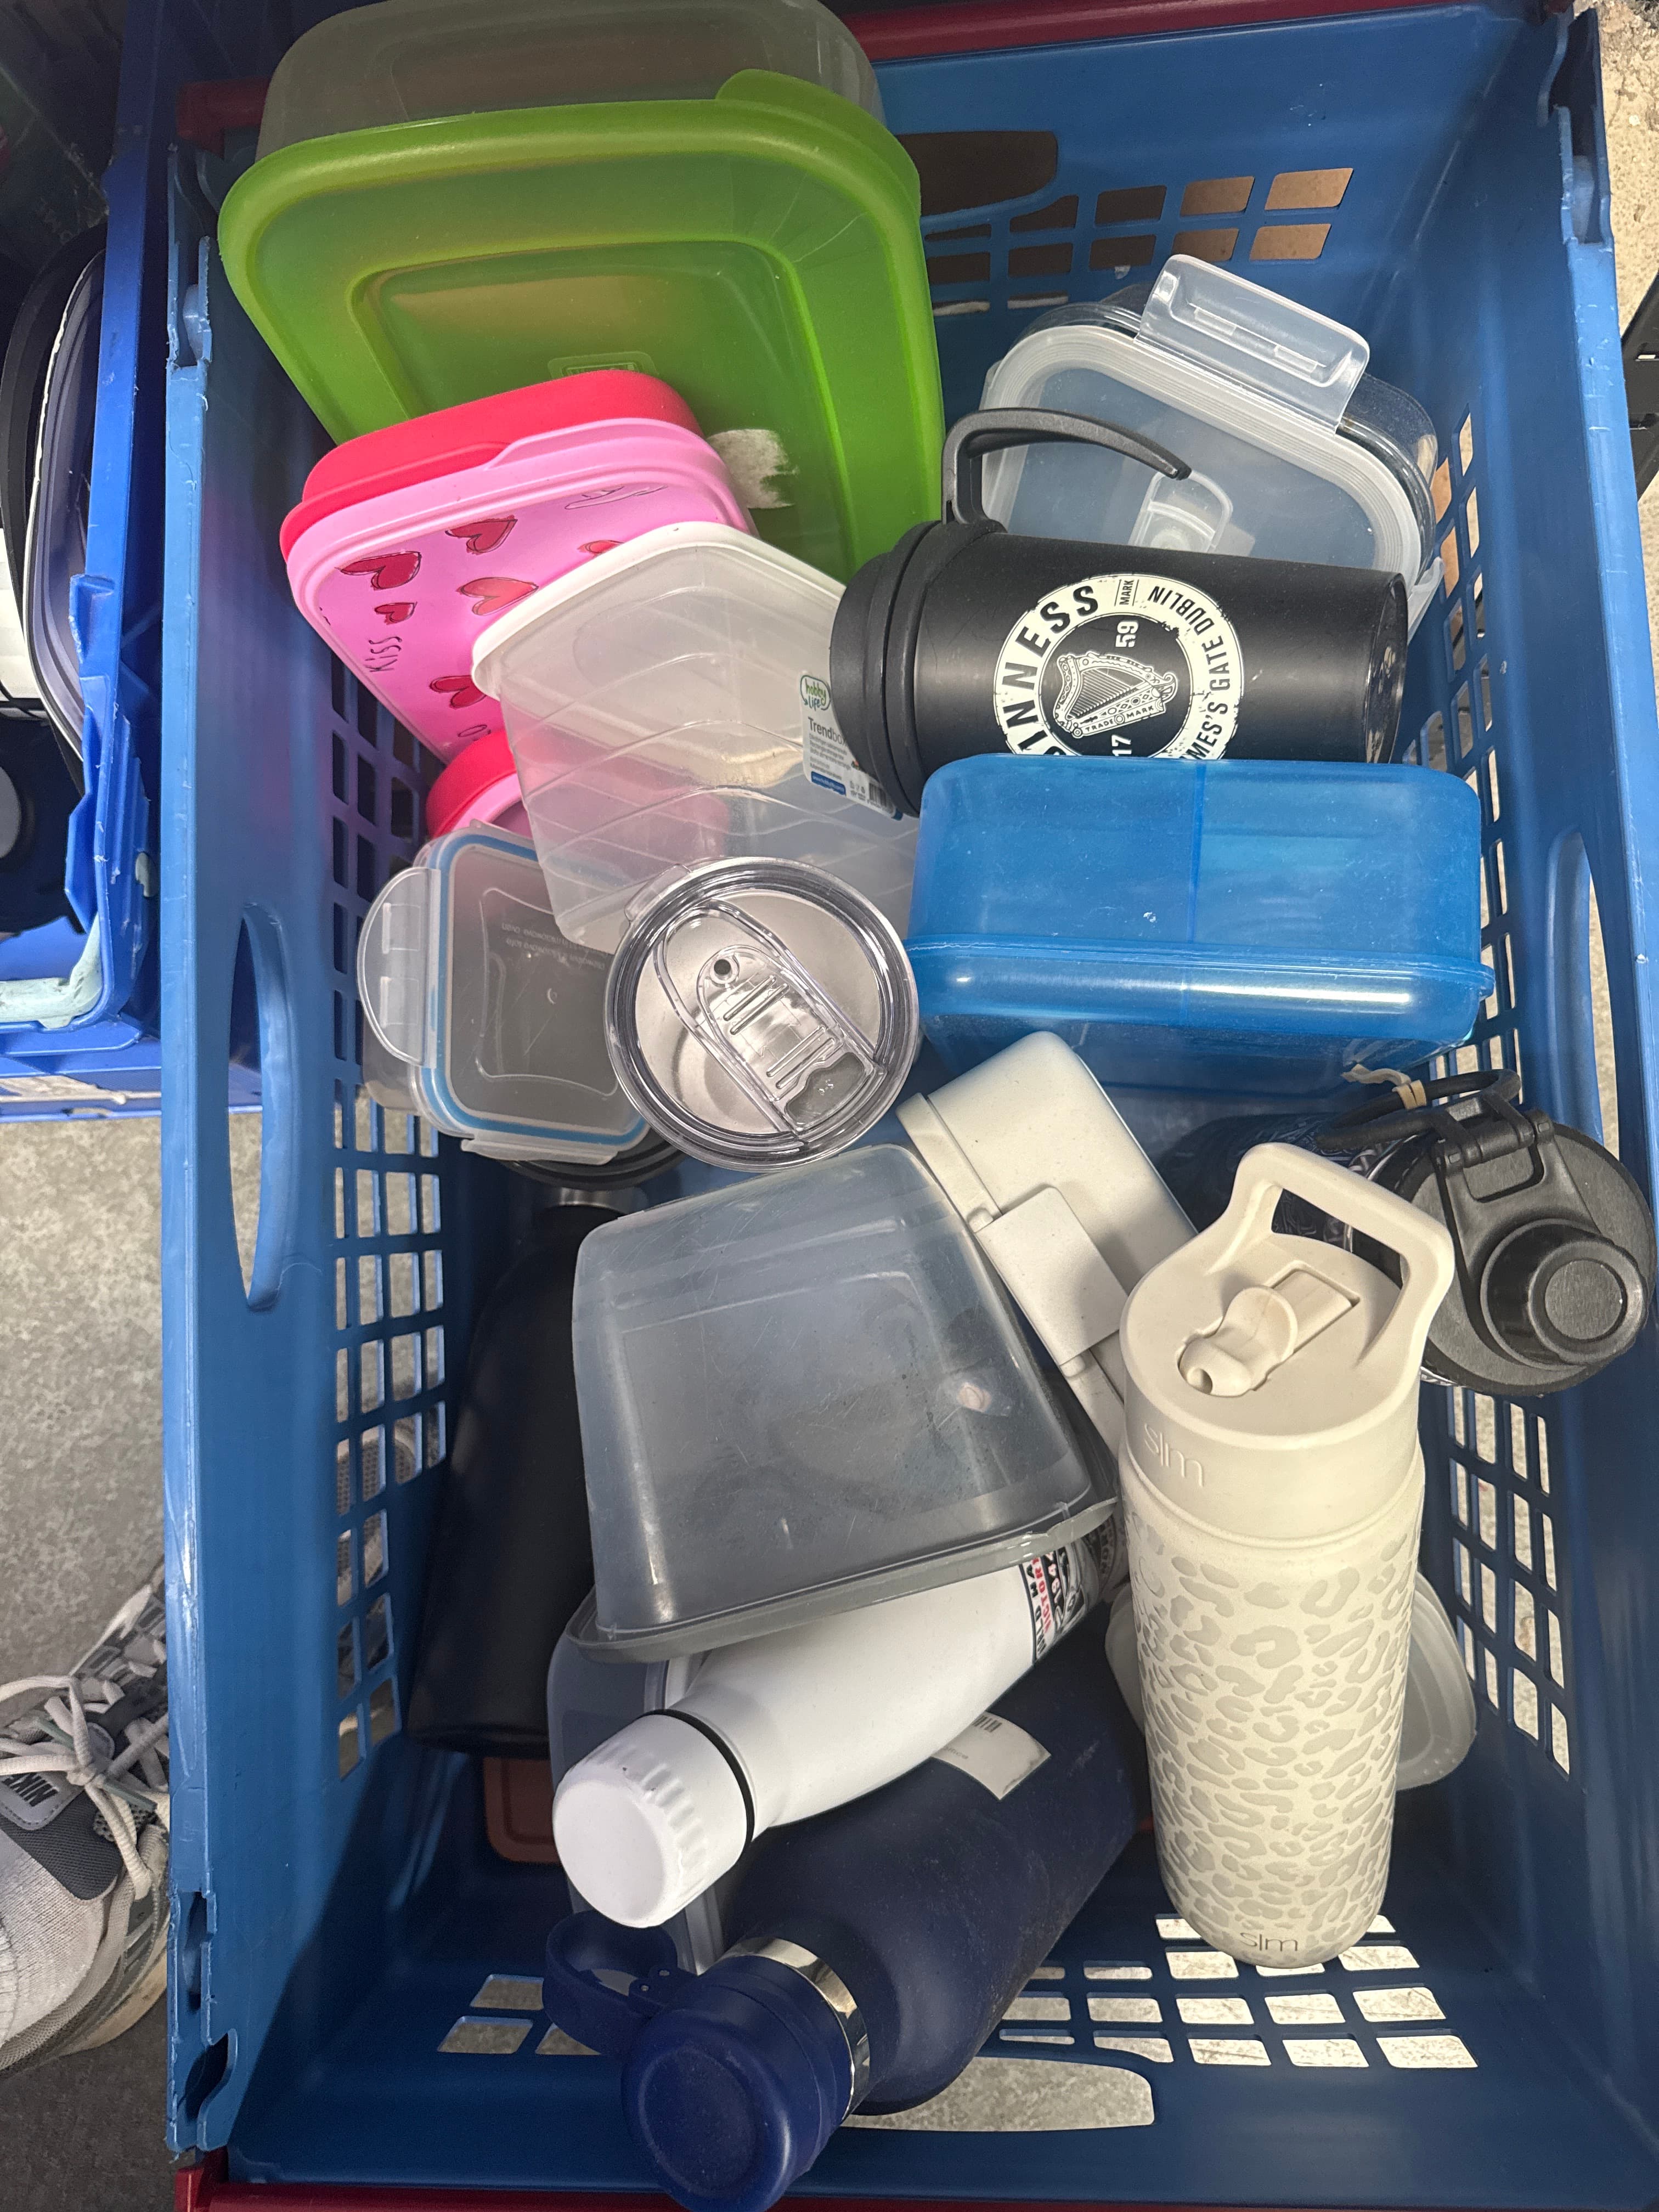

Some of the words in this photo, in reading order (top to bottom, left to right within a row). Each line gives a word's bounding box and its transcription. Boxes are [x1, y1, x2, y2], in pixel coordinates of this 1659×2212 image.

[1119, 579, 1135, 605] MARK
[1147, 585, 1215, 636] DUBLIN
[1115, 620, 1139, 648] 59
[1001, 585, 1099, 755] INNESS
[1201, 635, 1231, 692] GATE
[804, 678, 827, 707] hobby
[1085, 719, 1114, 732] TRADE
[1126, 705, 1154, 719] MARK
[1180, 701, 1228, 760] MES'S
